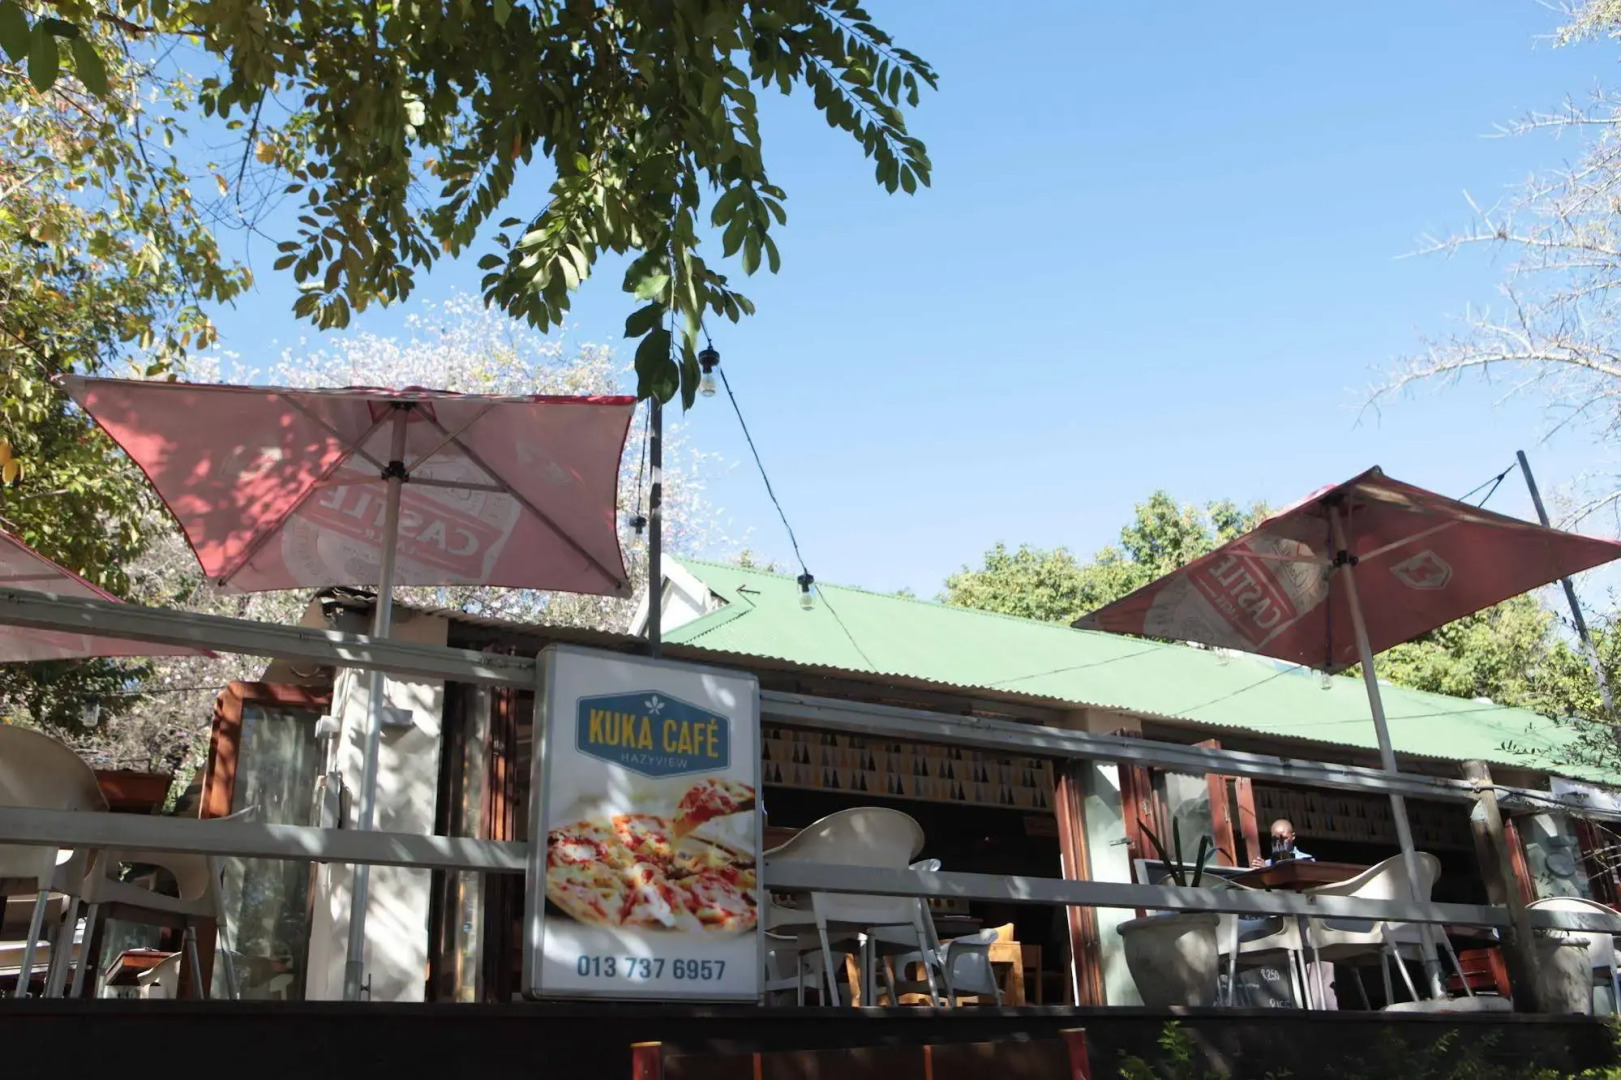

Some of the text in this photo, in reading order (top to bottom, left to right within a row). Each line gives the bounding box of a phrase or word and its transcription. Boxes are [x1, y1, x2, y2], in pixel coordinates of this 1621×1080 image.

[589, 709, 720, 758] KUKA CAFÉ
[621, 753, 688, 768] HAZYVIEW
[577, 955, 726, 981] 013 737 6957
